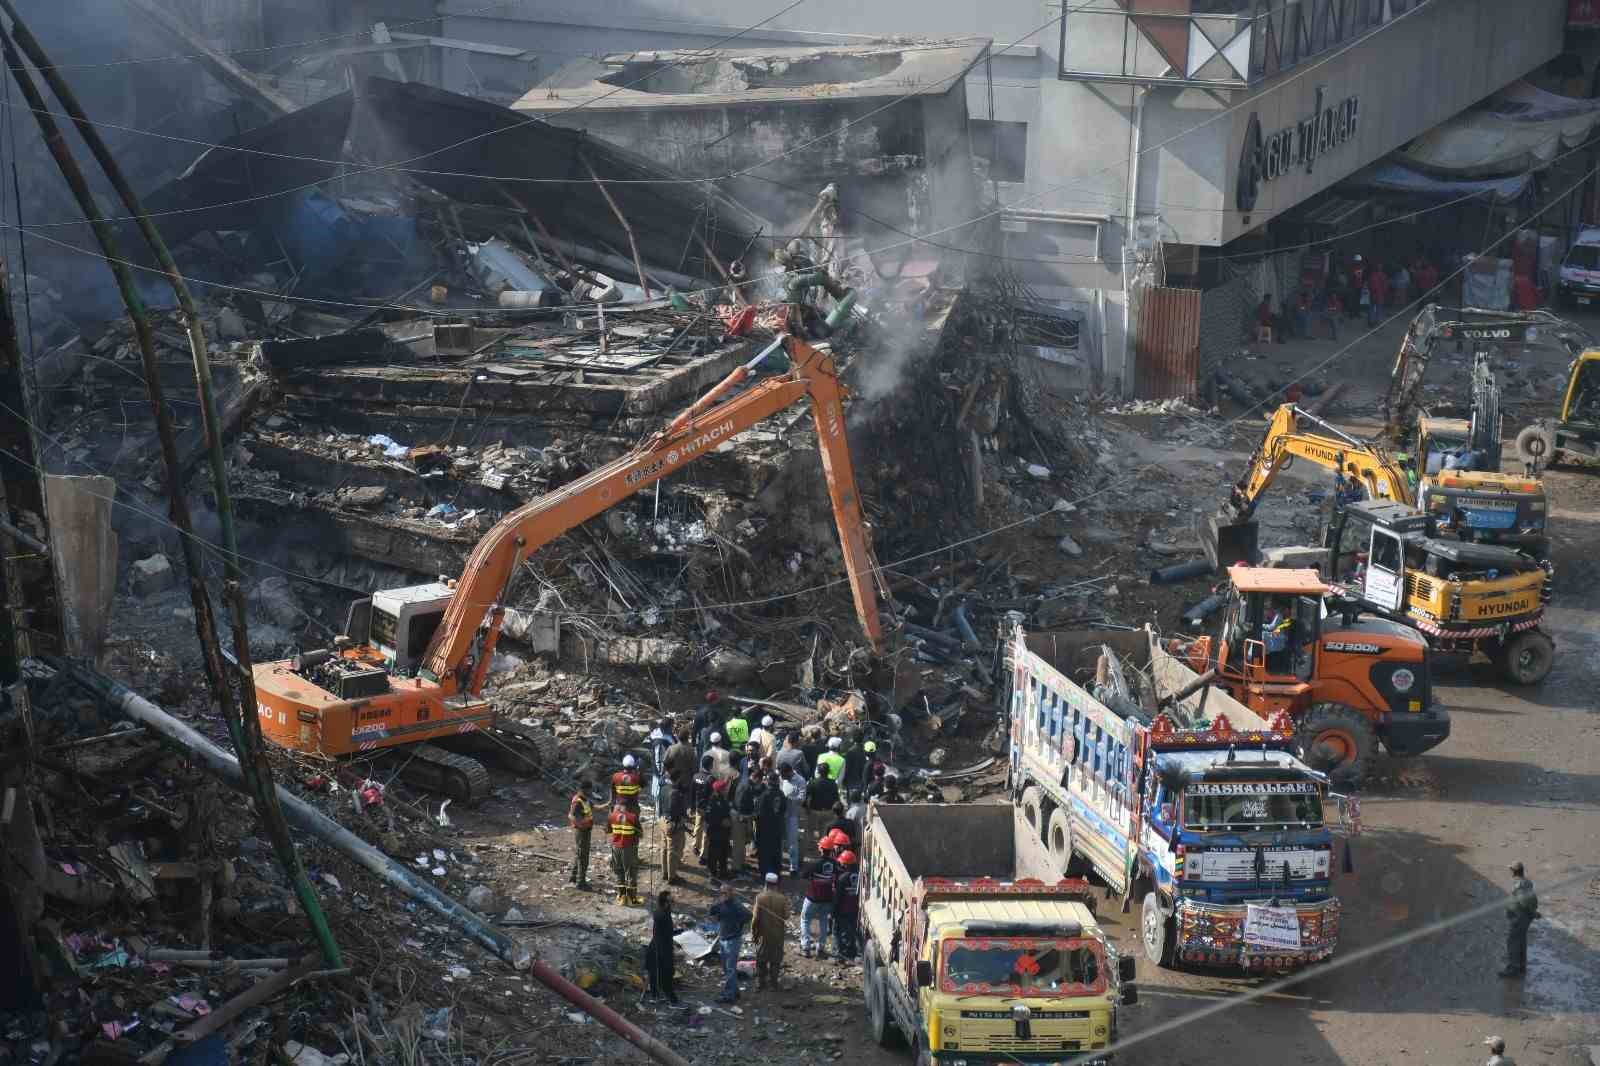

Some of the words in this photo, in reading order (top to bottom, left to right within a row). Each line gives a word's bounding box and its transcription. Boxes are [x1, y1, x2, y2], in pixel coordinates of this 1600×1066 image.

[1463, 329, 1511, 338] VOLVO
[680, 420, 734, 456] HITACHI
[1304, 444, 1337, 461] HYUND
[1478, 600, 1529, 616] HYUNDAI
